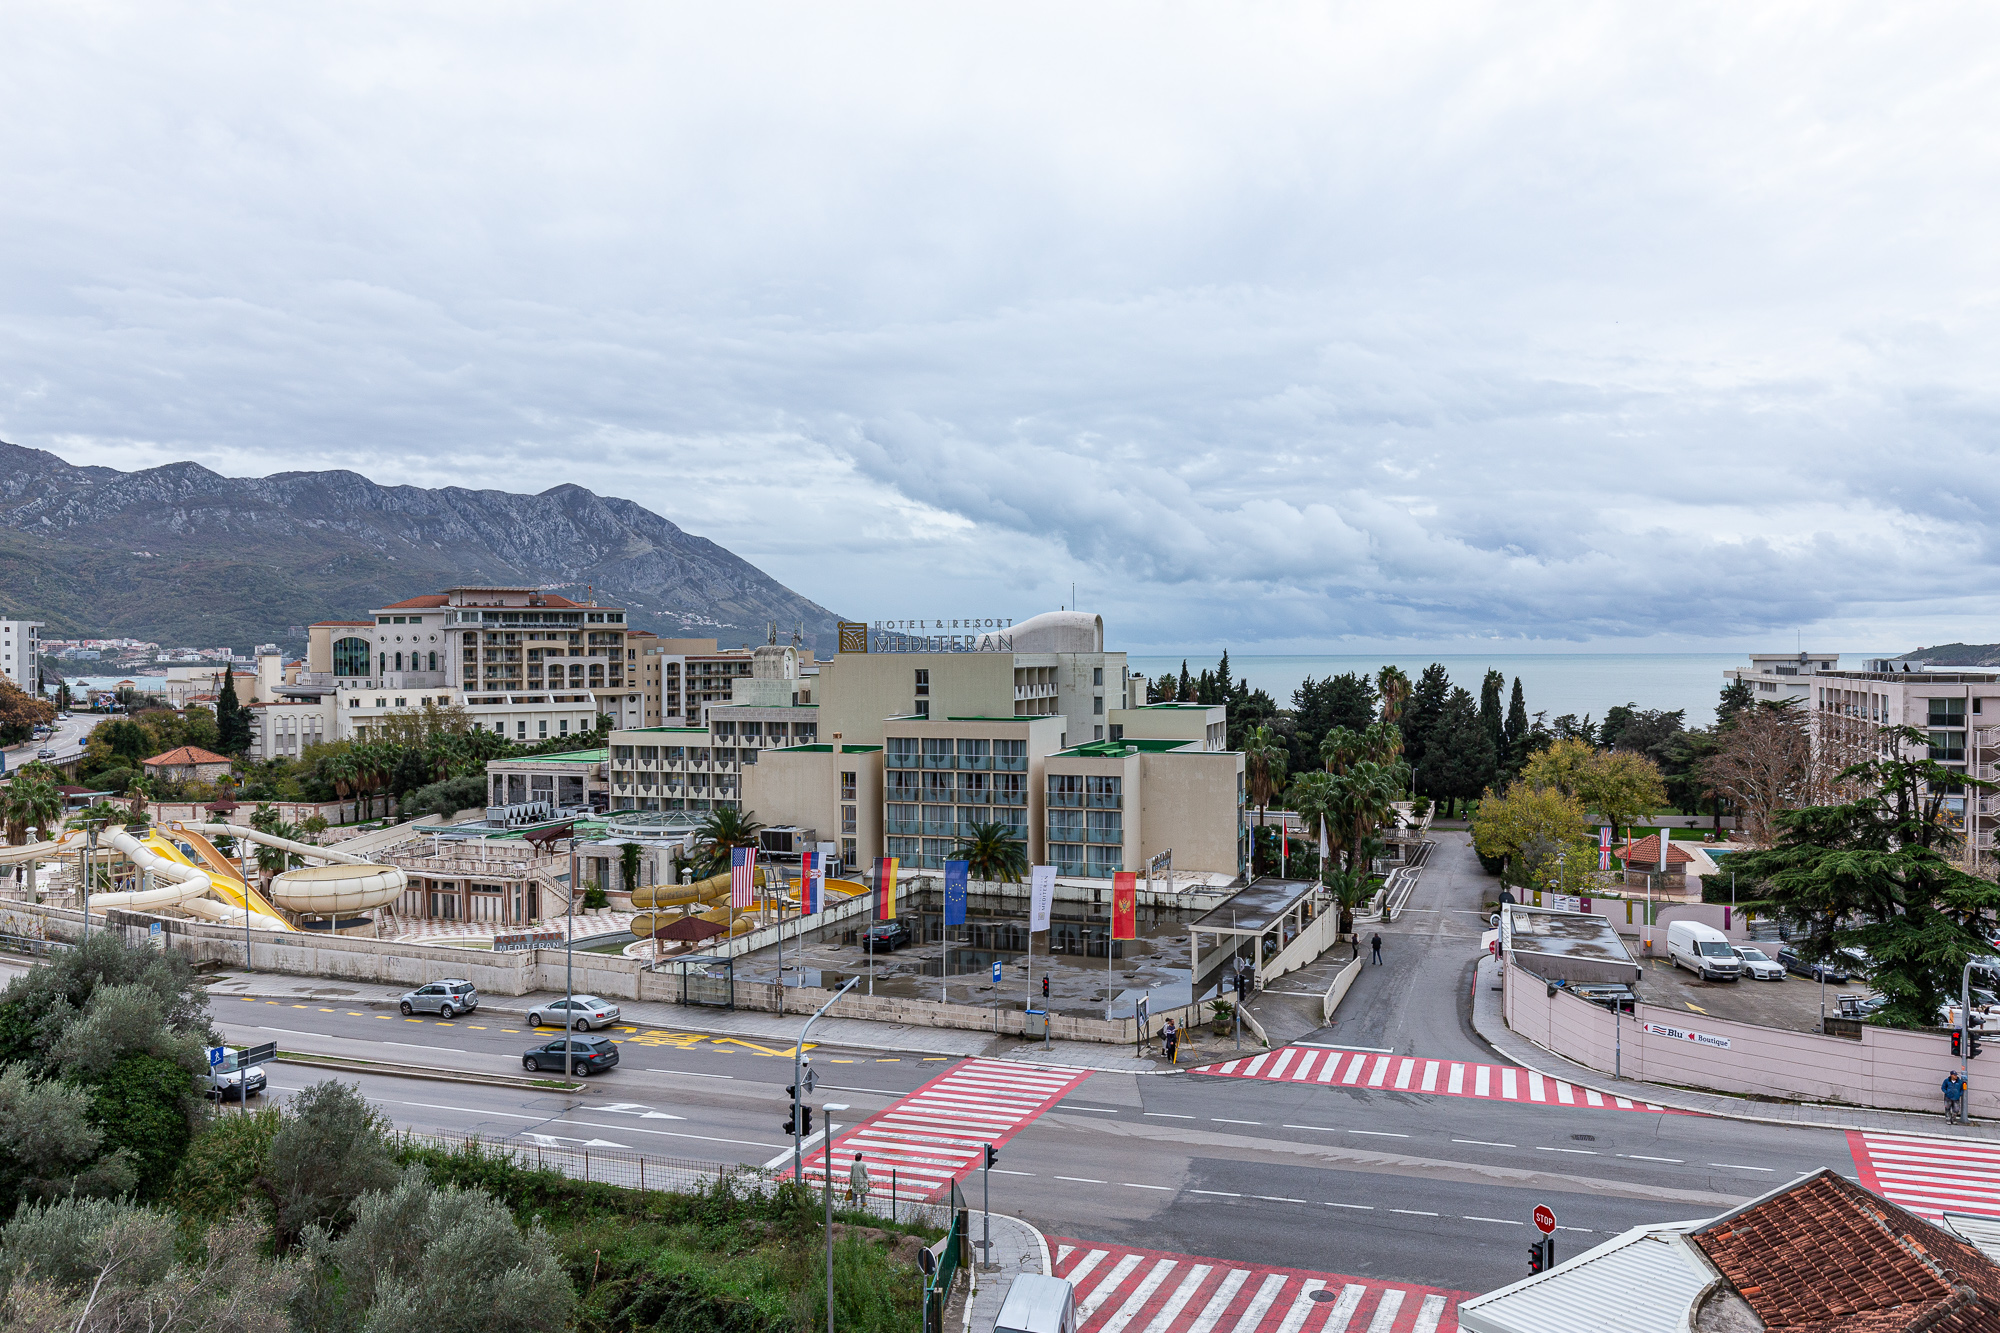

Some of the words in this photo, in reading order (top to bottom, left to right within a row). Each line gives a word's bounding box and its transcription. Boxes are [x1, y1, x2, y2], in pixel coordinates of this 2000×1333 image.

[875, 620, 925, 630] HOTEL
[936, 619, 943, 629] &
[953, 618, 1012, 629] RESORT
[874, 634, 1012, 652] MEDITERAN
[494, 934, 527, 944] AQUA
[532, 932, 563, 942] PARK
[499, 942, 559, 951] MEDITERAN
[1667, 1028, 1683, 1039] Blu
[1698, 1034, 1728, 1047] Boutique
[1536, 1212, 1553, 1227] STOP
